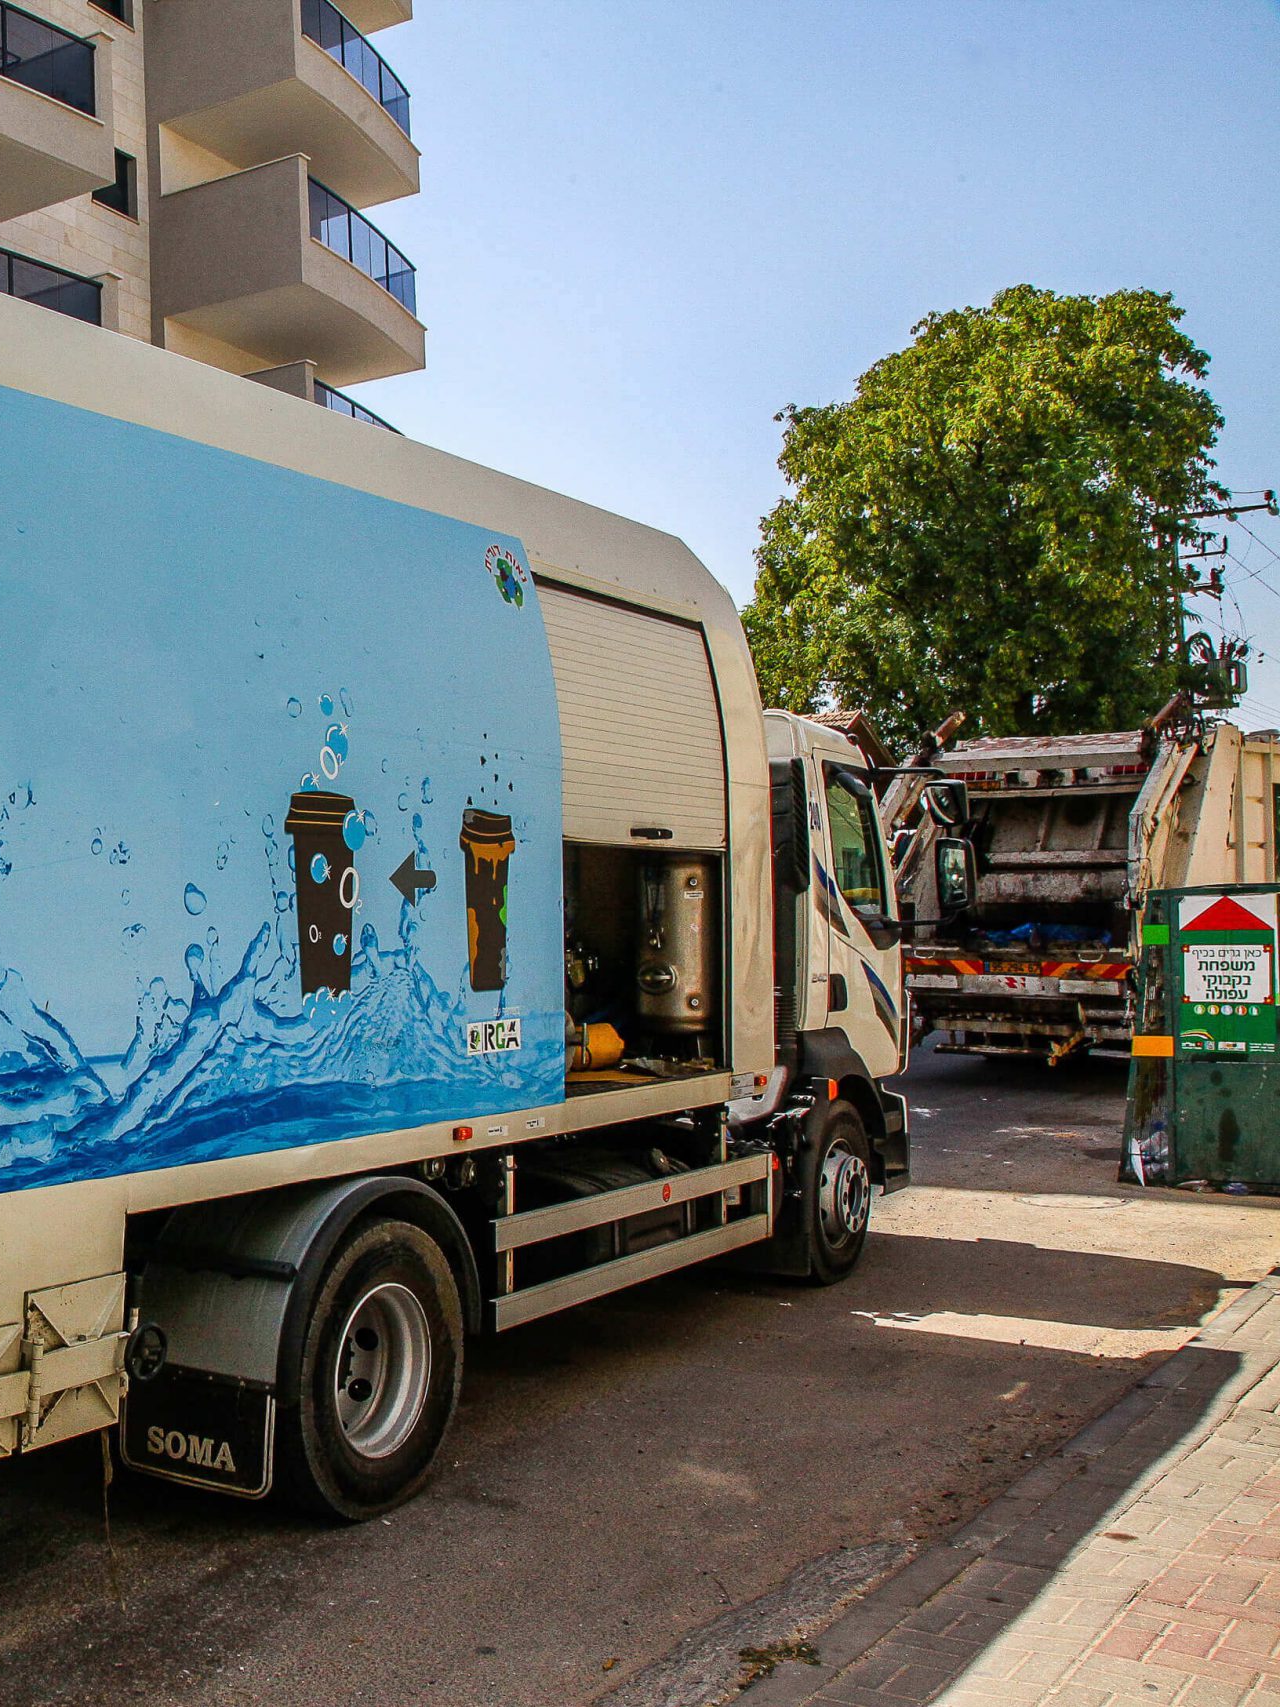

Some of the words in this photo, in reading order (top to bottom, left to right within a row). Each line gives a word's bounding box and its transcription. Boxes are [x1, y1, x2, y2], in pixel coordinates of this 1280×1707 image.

[1191, 949, 1215, 959] בכיף
[1218, 949, 1240, 958] גרים
[1244, 949, 1262, 959] כאן
[1197, 960, 1256, 971] משפחת
[1201, 974, 1252, 988] בקבוקי
[1205, 986, 1248, 999] עפולה
[146, 1425, 236, 1473] SOMA
